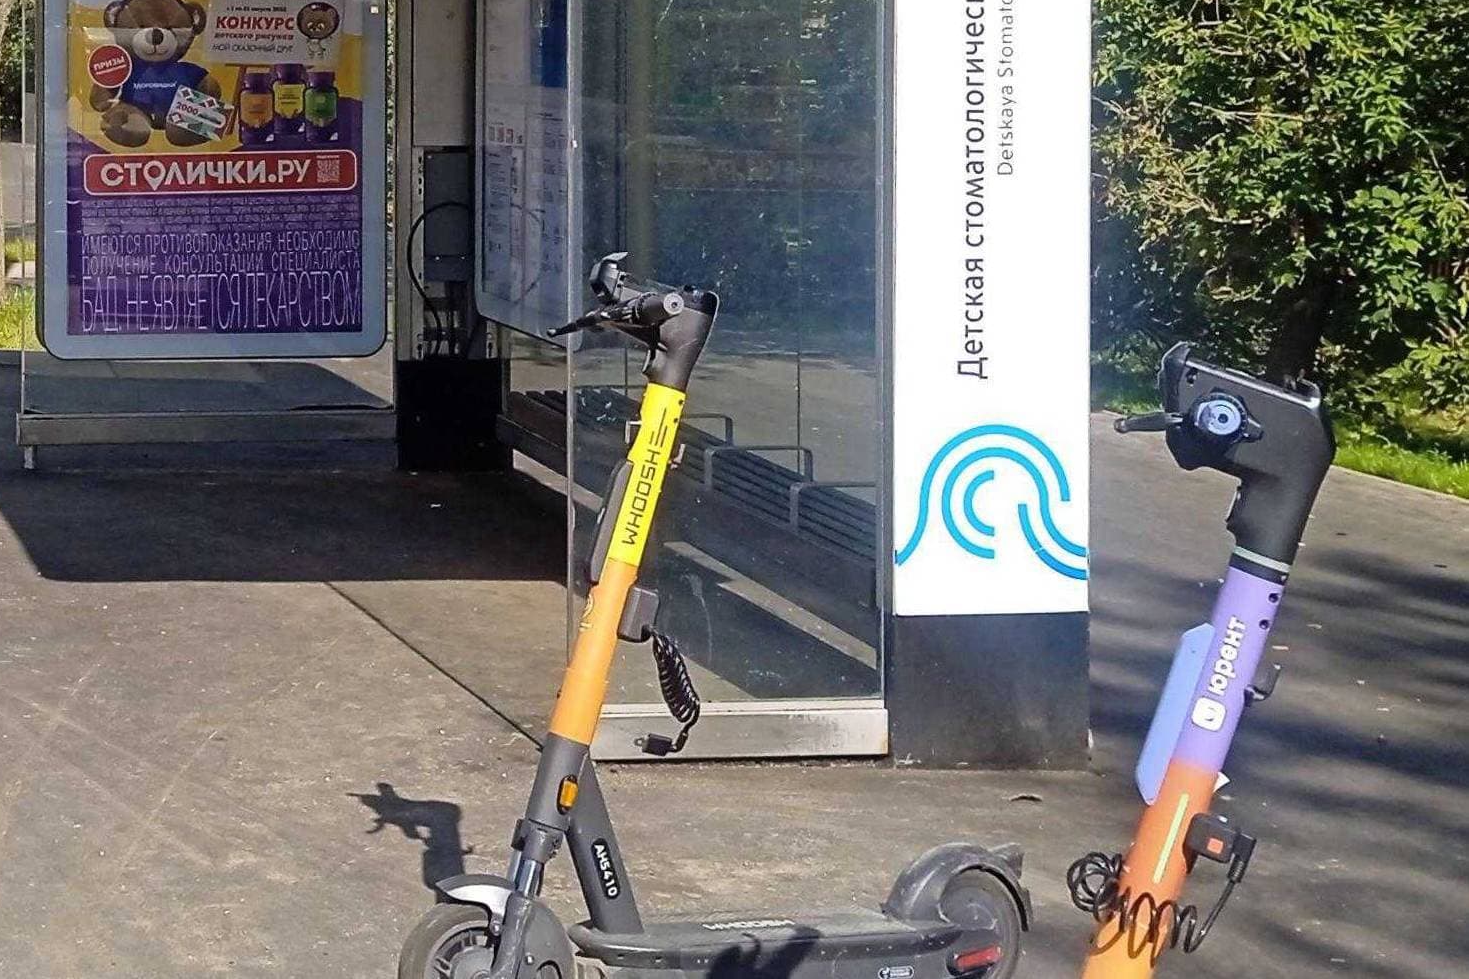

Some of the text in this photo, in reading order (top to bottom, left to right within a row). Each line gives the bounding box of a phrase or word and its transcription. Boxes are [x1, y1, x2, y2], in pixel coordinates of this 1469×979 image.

[216, 16, 295, 30] КОНКУРС
[254, 33, 294, 42] рисунка
[93, 55, 125, 71] ПРИЗЫ
[996, 84, 1017, 176] Detskaya
[99, 158, 312, 192] СТОЛИЧКИ.РУ
[81, 234, 141, 255] ИМЕЮТСЯ
[277, 230, 360, 251] НЕОБХОДИМО
[81, 250, 361, 276] ПОЛУЧЕНИЕ КОНСУЛЬТАЦИИ СПЕЦИАЛИСТА
[126, 274, 149, 331] НЕ
[152, 272, 240, 330] ЯВЛЯЕТСЯ
[243, 270, 361, 328] ЛЕКАРСТВОМ
[957, 257, 989, 380] Детская
[621, 448, 661, 545] WHOOSH
[1207, 615, 1246, 697] юрент
[593, 844, 618, 897] AH5410
